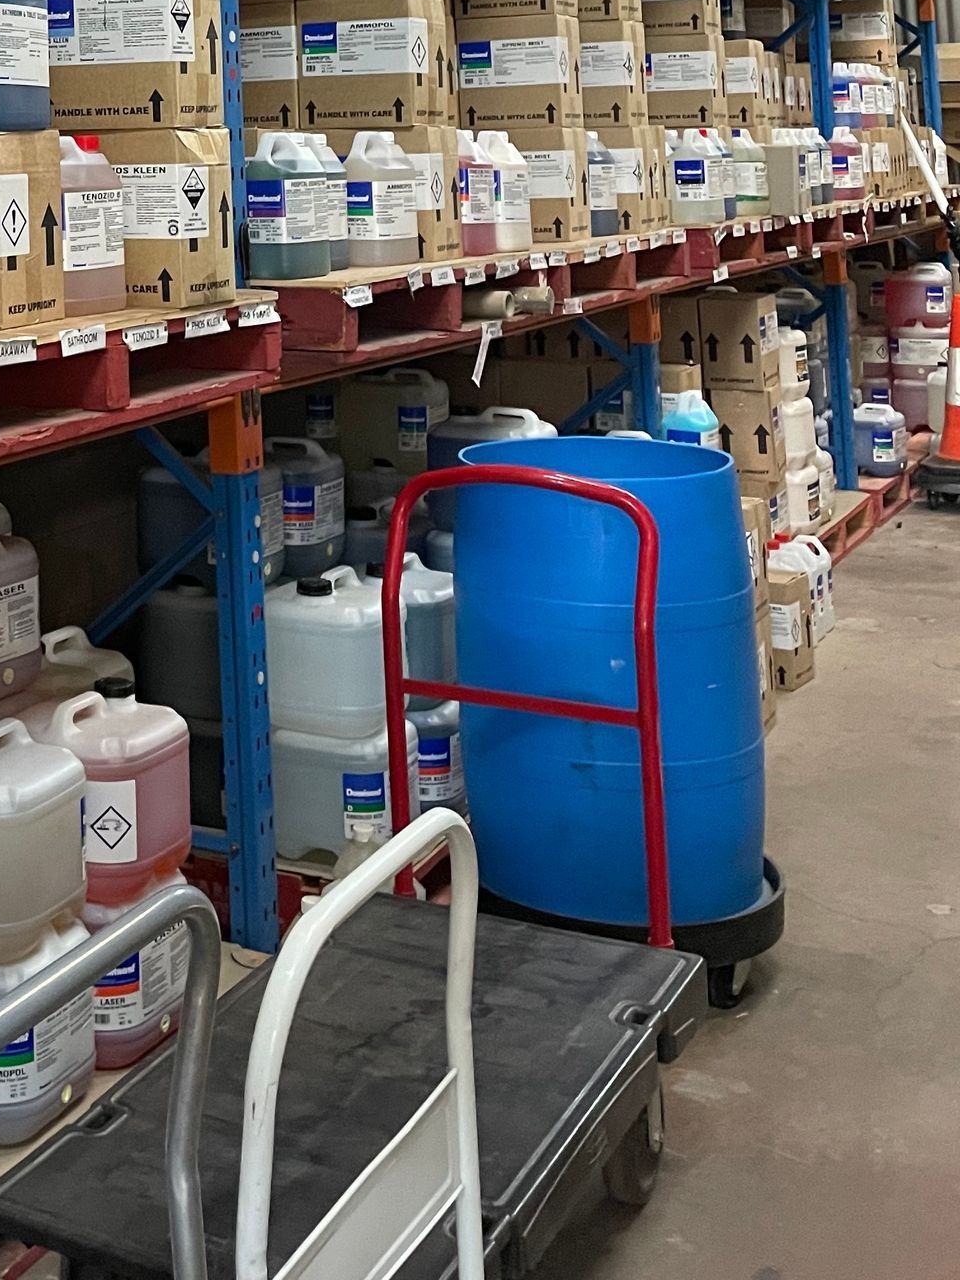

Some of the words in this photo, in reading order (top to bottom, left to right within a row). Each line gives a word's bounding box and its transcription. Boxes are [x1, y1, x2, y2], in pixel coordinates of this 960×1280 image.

[349, 21, 395, 29] AMMOPOL
[54, 107, 93, 118] HANDLE
[95, 107, 121, 117] WITH
[123, 105, 150, 116] CARE
[316, 111, 348, 119] HANDLE
[349, 110, 370, 118] WITH
[372, 109, 393, 118] CARE
[133, 165, 167, 175] KLEEN
[81, 190, 115, 202] TENOZID
[131, 284, 159, 294] CARE
[8, 302, 27, 315] KEEP
[27, 297, 58, 312] UPRIGHT
[67, 330, 99, 348] BATHROOM
[100, 997, 126, 1007] LASER
